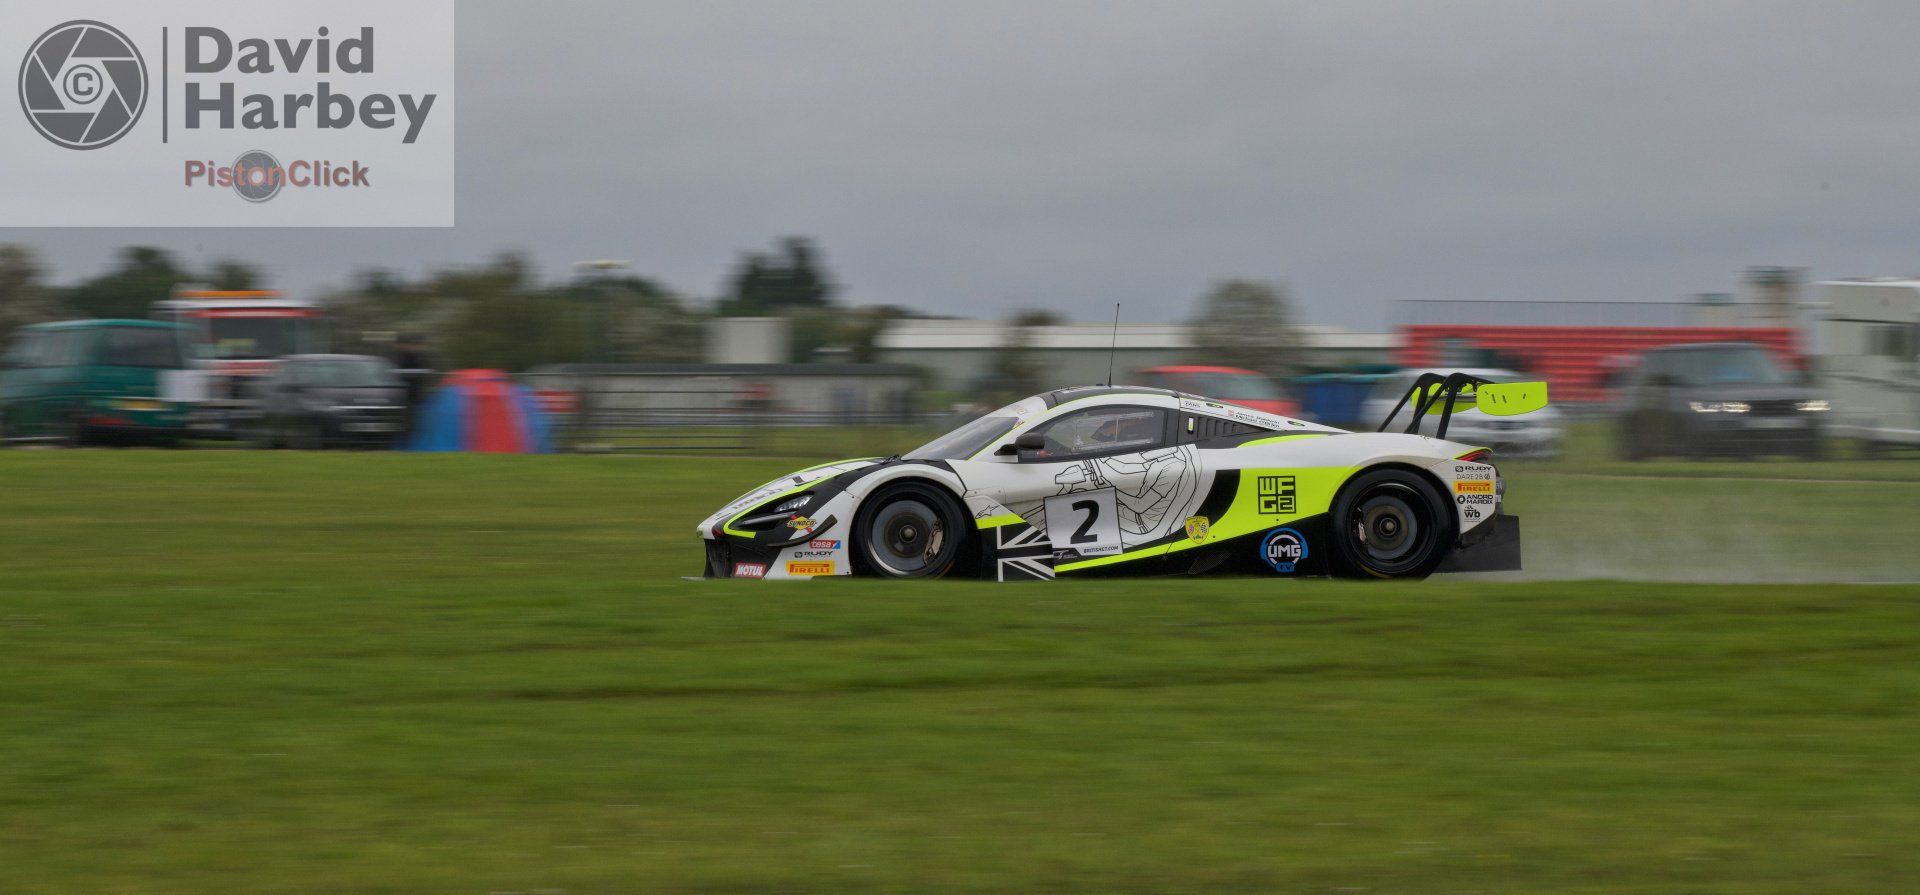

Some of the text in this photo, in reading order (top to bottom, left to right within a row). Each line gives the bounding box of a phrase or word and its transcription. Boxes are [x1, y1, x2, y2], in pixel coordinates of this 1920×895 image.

[1458, 483, 1490, 492] PIRELLI
[788, 520, 816, 528] SUNOCO
[1070, 499, 1100, 545] 2
[1267, 544, 1302, 558] UMG
[736, 564, 764, 576] MOTUL
[790, 563, 830, 573] PIRELLI
